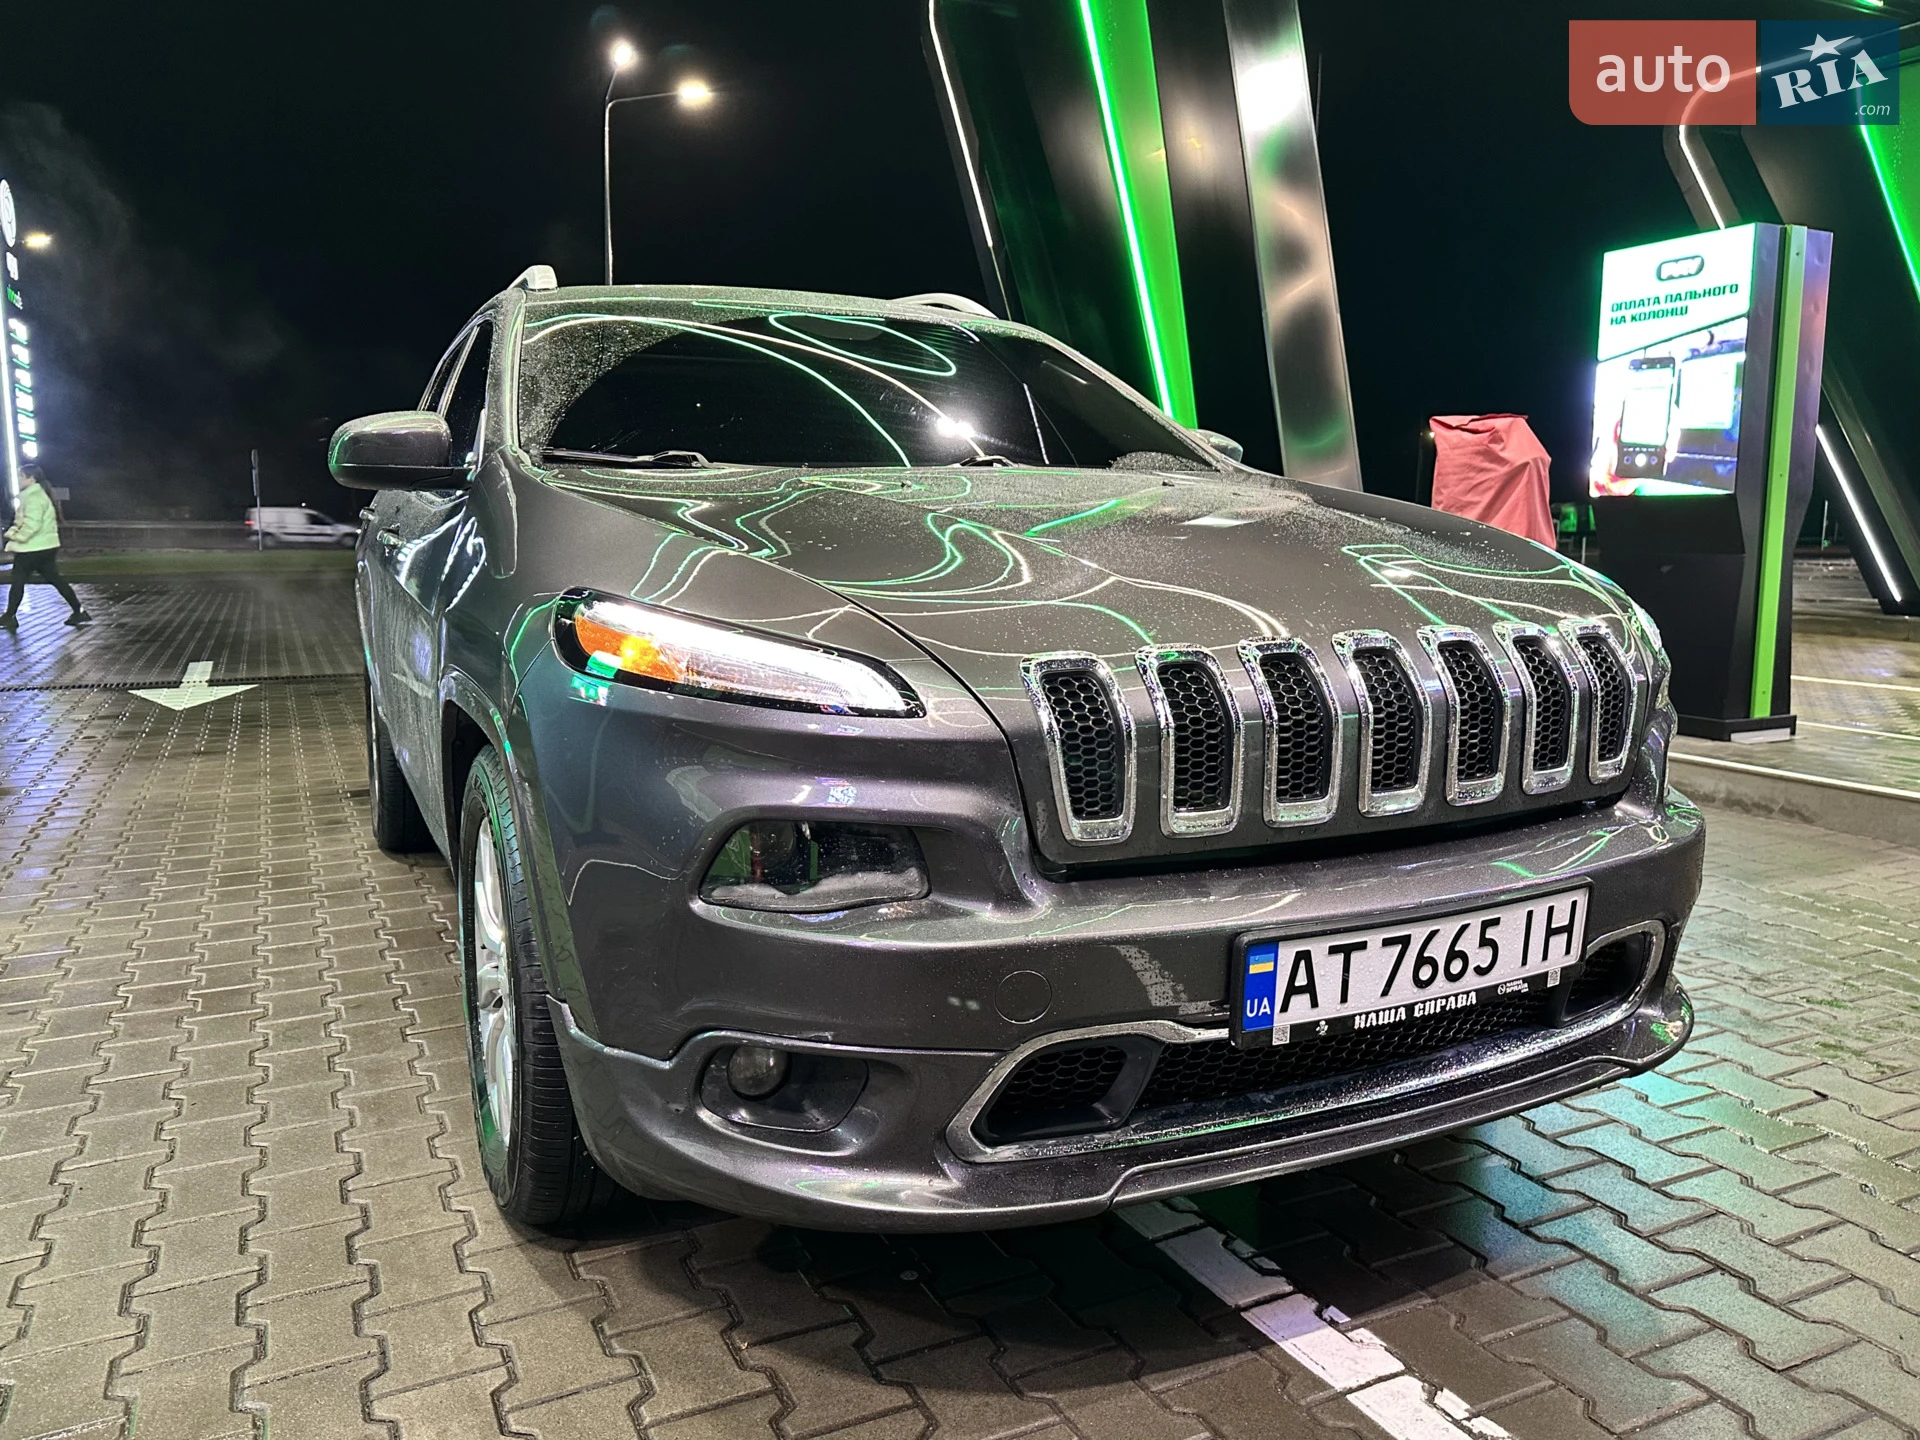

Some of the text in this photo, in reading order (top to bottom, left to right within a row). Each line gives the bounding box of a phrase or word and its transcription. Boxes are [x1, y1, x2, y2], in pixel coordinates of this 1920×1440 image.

[1611, 283, 1739, 313] ОПЛАТА ПАЛЬНОГО
[1610, 315, 1627, 326] НА
[1279, 900, 1578, 1013] AT 7665 IH
[1246, 997, 1271, 1017] UA
[1354, 991, 1477, 1030] НАША СПРАВА
